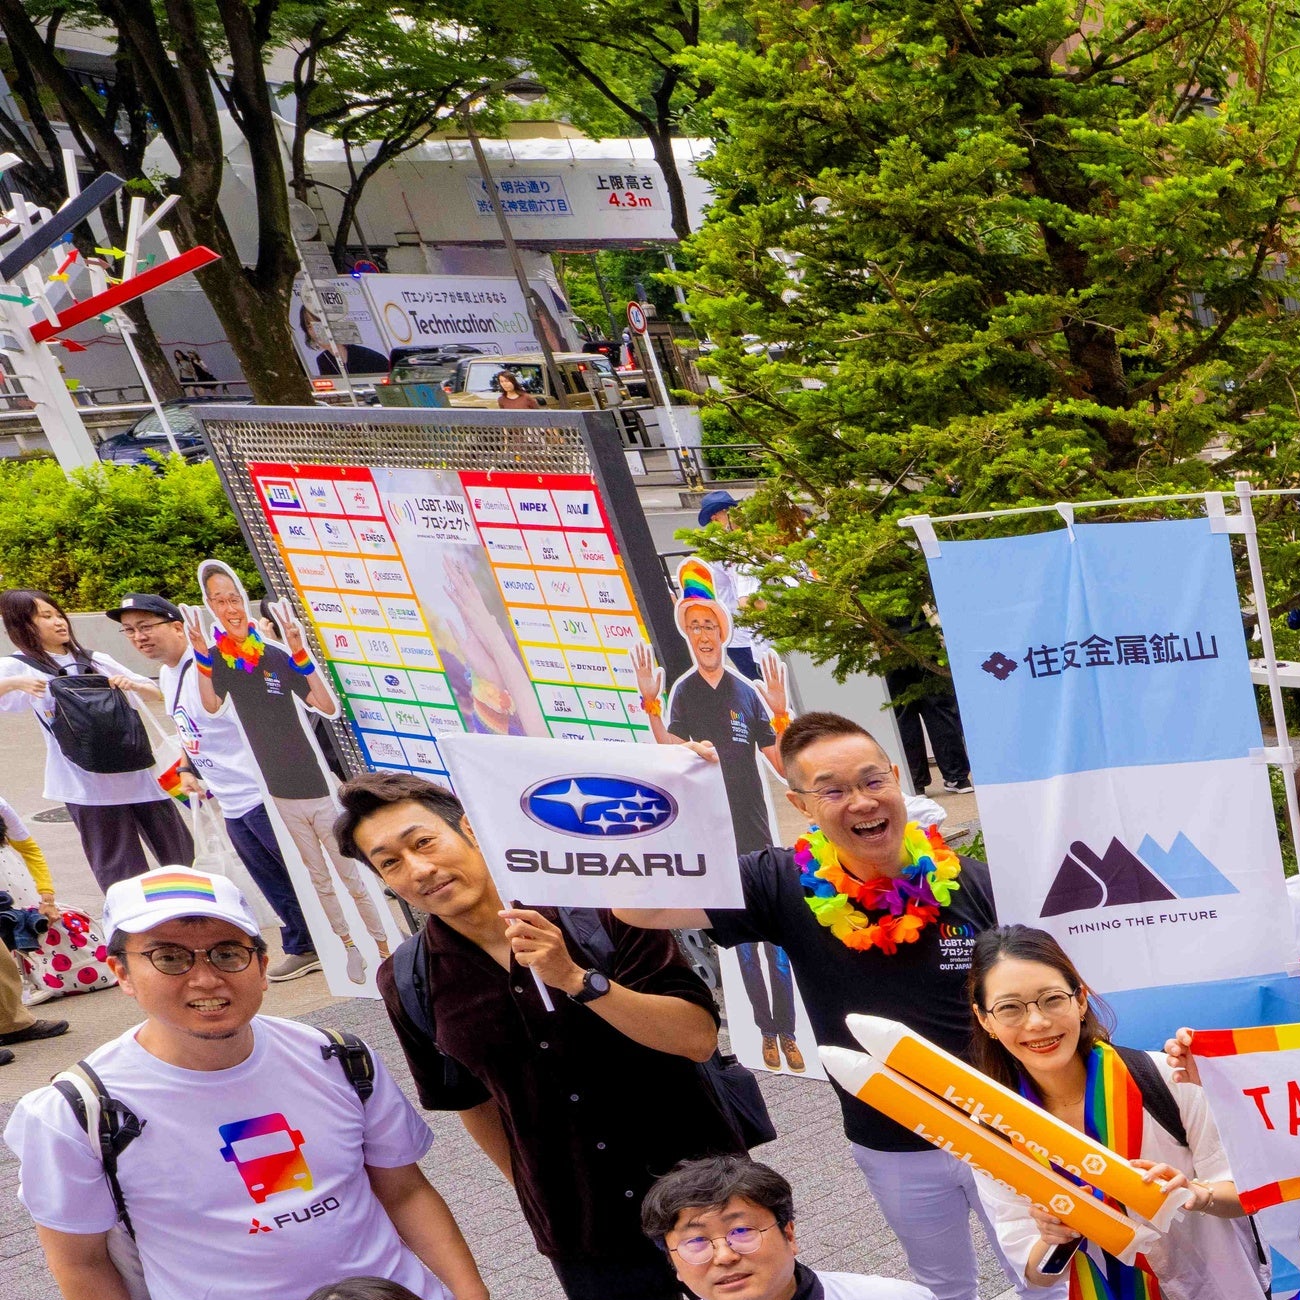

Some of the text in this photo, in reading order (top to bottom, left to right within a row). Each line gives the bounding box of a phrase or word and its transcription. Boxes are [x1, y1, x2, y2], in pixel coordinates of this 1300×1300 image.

[501, 180, 550, 194] 明治通り
[597, 175, 653, 190] 上限高さ
[609, 192, 652, 207] 4.3m
[402, 291, 507, 304] ITエンジニアが年収上げるなら
[273, 488, 291, 500] IHI
[415, 498, 464, 514] LGBT-Ally
[520, 502, 548, 512] INPEX
[566, 504, 583, 514] ANA
[421, 515, 470, 532] プロジェクト
[289, 526, 305, 536] AGC
[1022, 631, 1219, 680] 住友金属鉱山
[576, 663, 607, 672] DUNLOP
[587, 700, 616, 711] SONY
[504, 848, 706, 877] SUBARU
[1068, 908, 1218, 936] MINING THE FUTURE
[939, 939, 976, 947] LGBT-Al
[940, 948, 973, 956] プロジェ
[273, 1196, 340, 1228] FUSO
